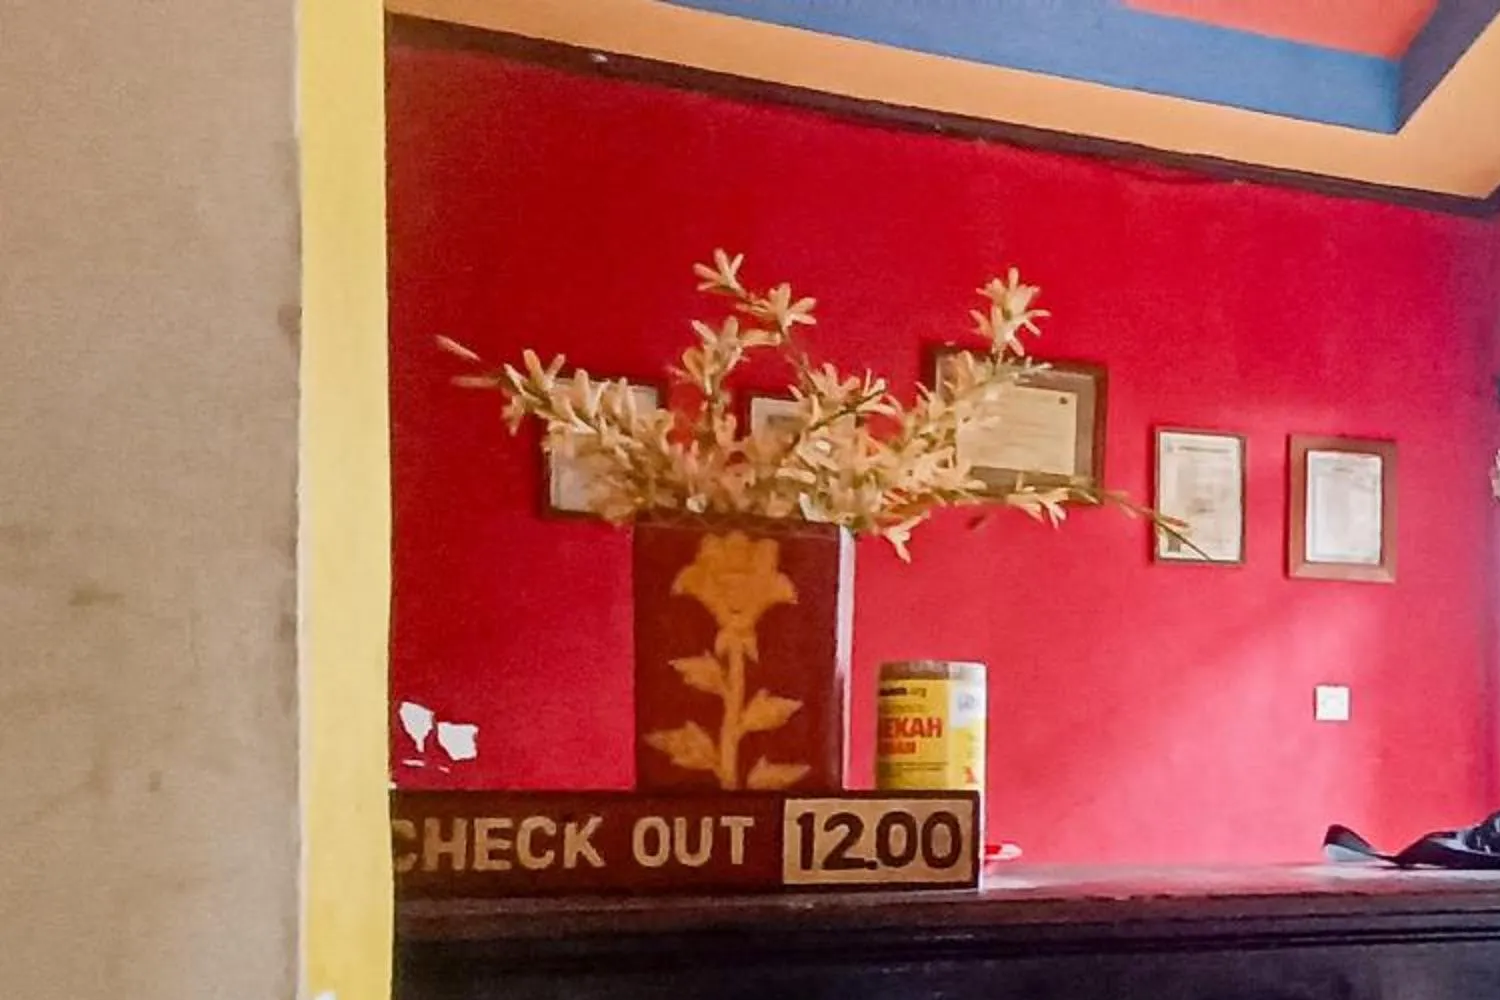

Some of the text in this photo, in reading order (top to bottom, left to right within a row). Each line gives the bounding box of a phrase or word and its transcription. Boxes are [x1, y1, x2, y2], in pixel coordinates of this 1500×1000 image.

[391, 811, 962, 872] CHECK OUT 12.00
